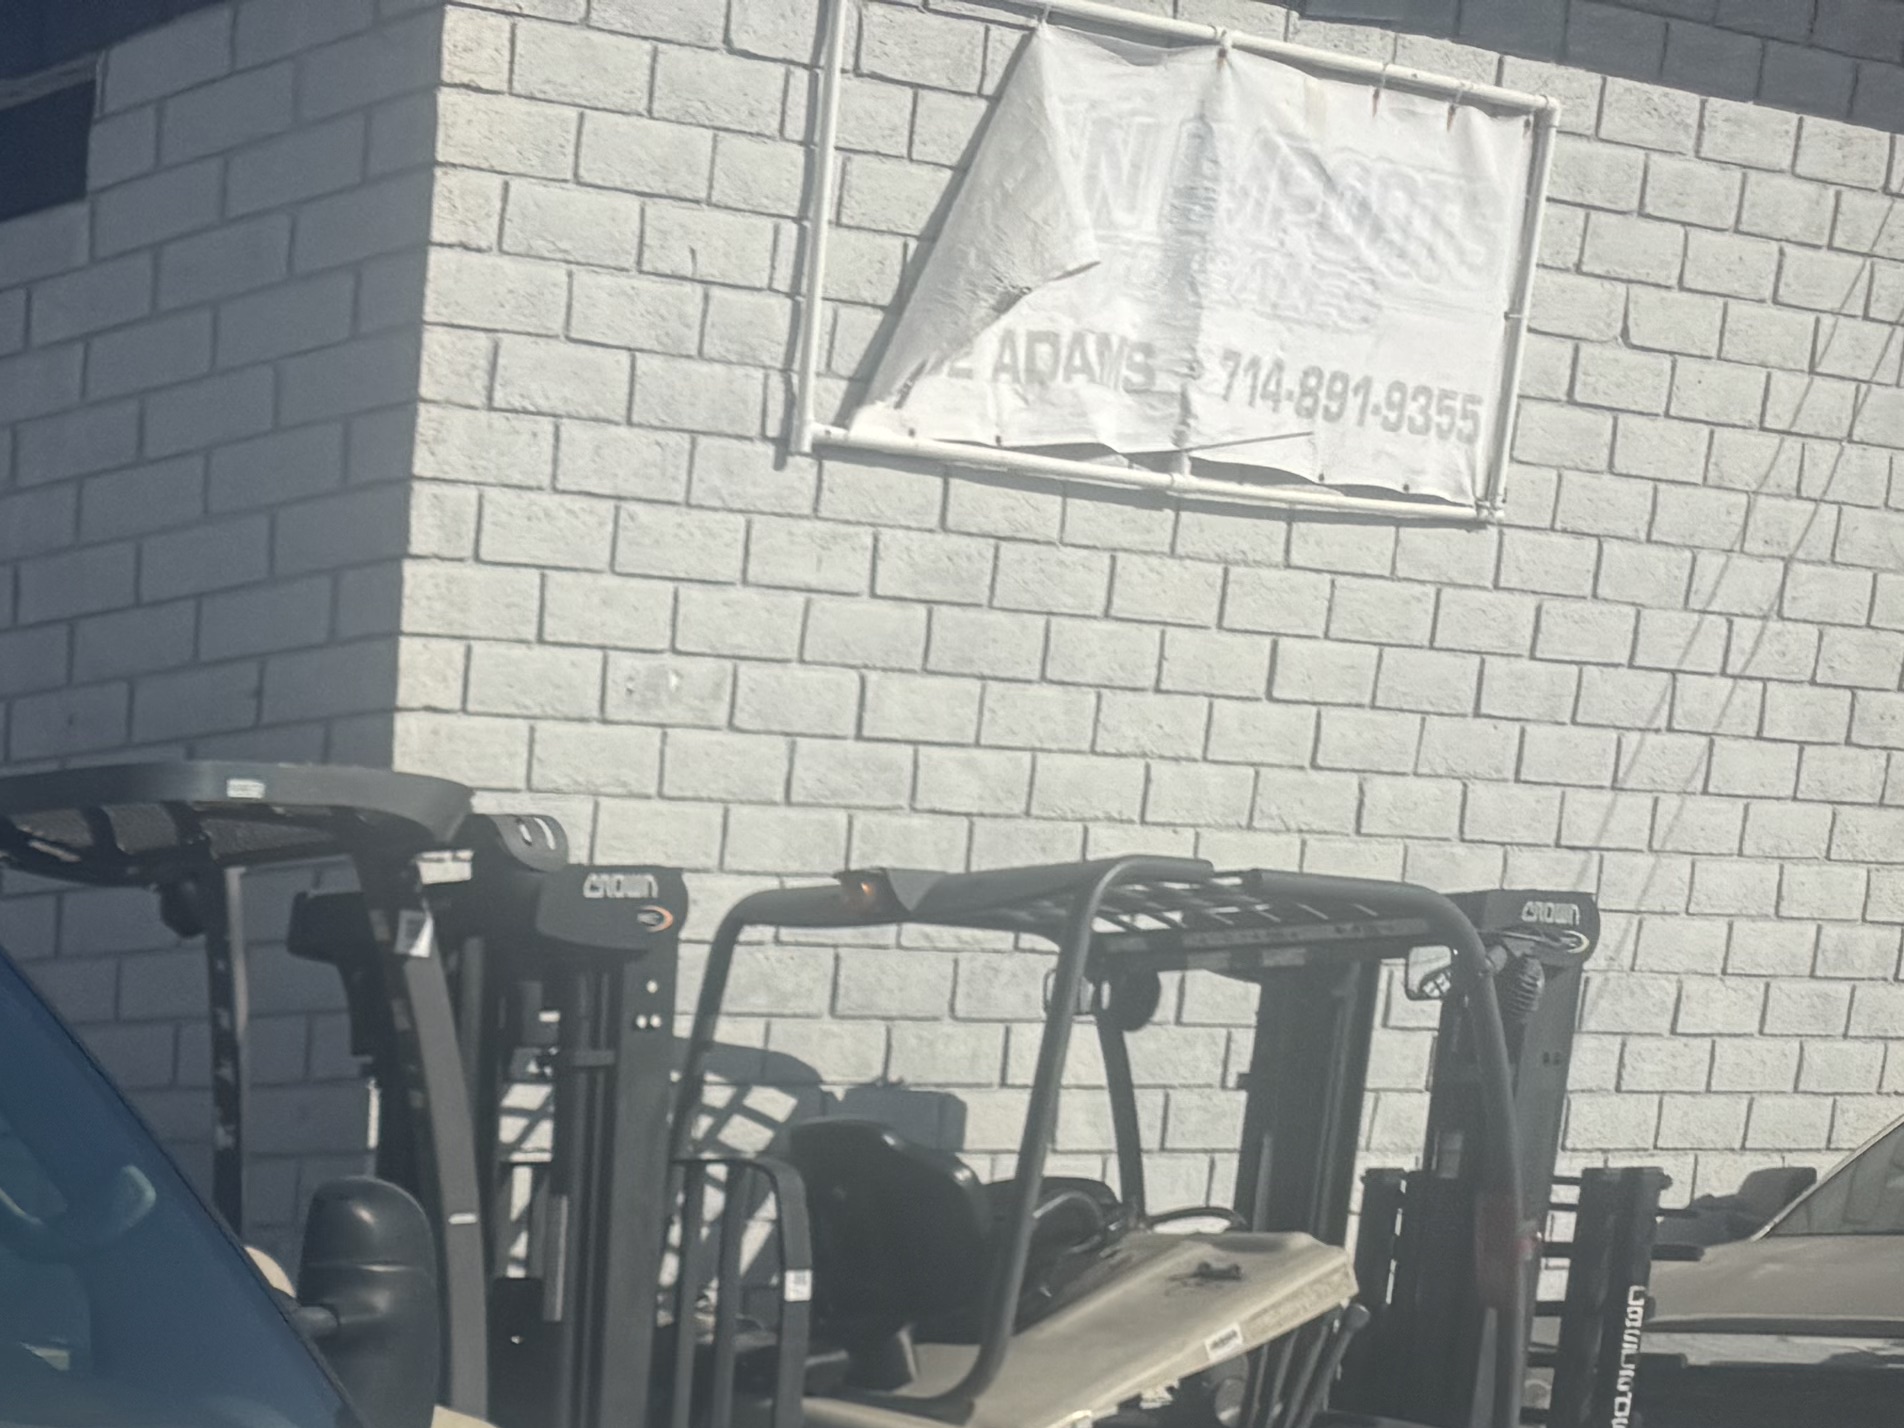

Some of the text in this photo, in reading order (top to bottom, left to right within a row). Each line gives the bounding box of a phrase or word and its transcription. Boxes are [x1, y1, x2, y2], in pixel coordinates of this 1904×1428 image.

[991, 327, 1157, 392] ADAMS
[1220, 348, 1485, 444] 714-891-9355
[582, 872, 659, 899] CROWN
[1521, 900, 1581, 926] CROWN
